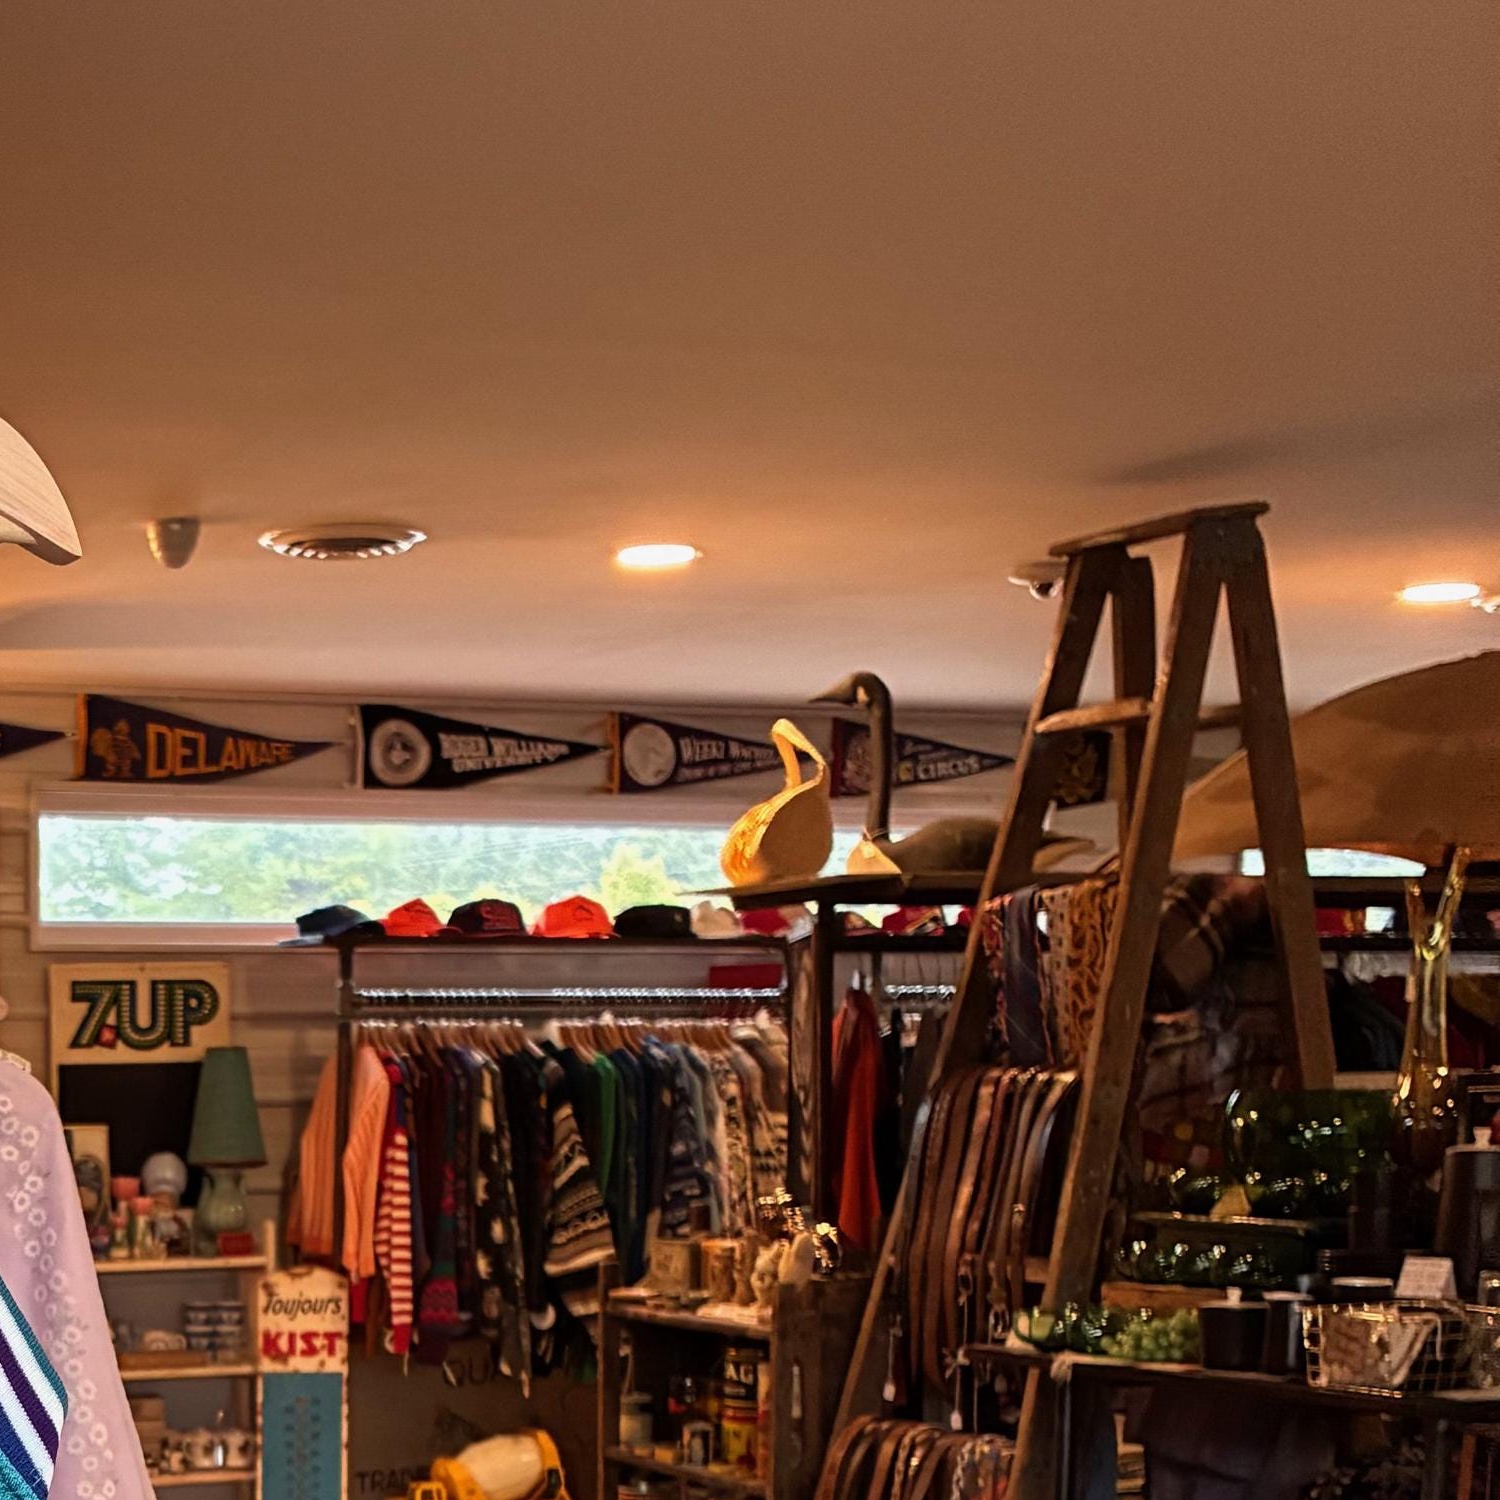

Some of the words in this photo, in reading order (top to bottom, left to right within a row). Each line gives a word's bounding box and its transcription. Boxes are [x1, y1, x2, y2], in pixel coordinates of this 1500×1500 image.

[146, 722, 294, 778] DELAWARE
[68, 979, 220, 1050] 7UP
[263, 1296, 342, 1321] Toujours
[262, 1330, 343, 1358] KIST
